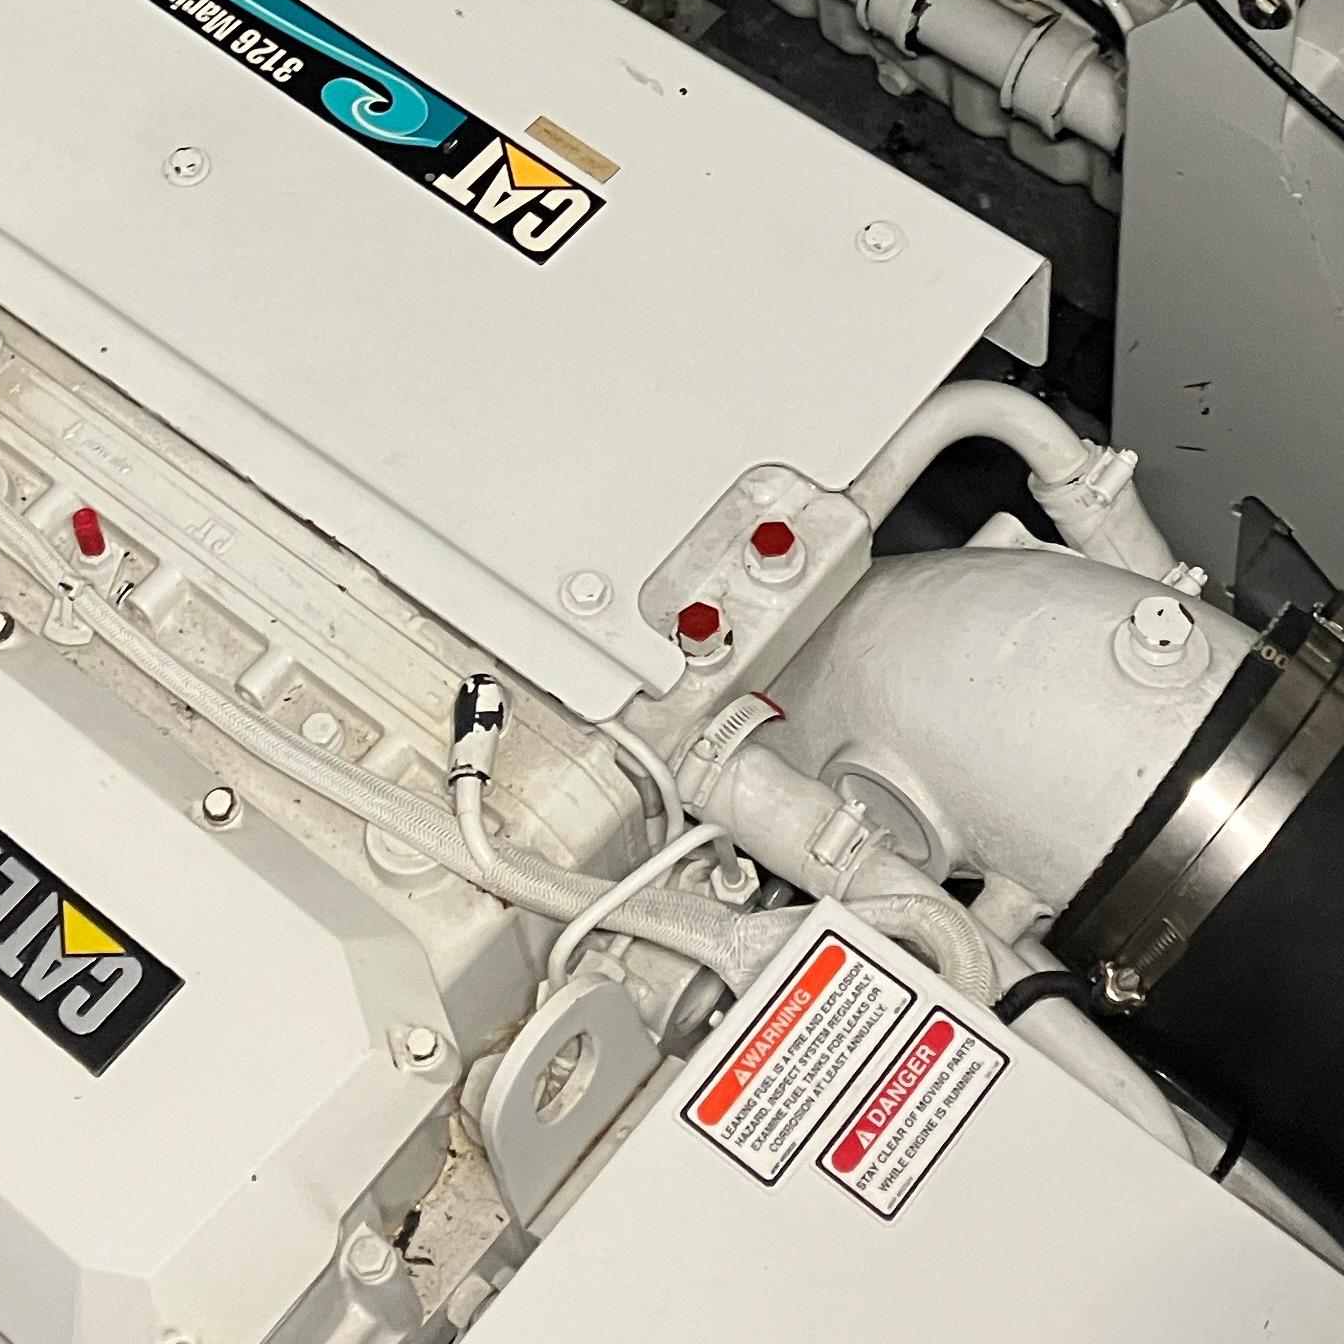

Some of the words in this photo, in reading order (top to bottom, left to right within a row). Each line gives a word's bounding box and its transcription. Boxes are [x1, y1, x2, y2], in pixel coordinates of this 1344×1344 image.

[230, 29, 304, 82] 3126
[432, 136, 591, 252] CAT
[720, 1097, 758, 1141] LEAKING
[753, 1072, 777, 1099] FUEL
[772, 1062, 785, 1075] IS
[780, 1053, 791, 1065] A
[786, 1032, 808, 1056] FIRE
[803, 1011, 825, 1035] AND
[819, 960, 864, 1014] EXPLOSION
[739, 986, 813, 1072] WARNING
[750, 1107, 787, 1152] EXAMINE
[782, 1082, 806, 1110] FUEL
[802, 1051, 830, 1084] TANKS
[825, 1031, 846, 1054] FOR
[841, 1001, 870, 1033] LEAKS
[865, 985, 881, 1003] OR
[766, 1064, 802, 1106] INSPECT
[797, 1026, 831, 1067] SYSTEM
[768, 1095, 816, 1154] CORROSION
[810, 1080, 827, 1098] AT
[821, 1051, 850, 1084] LEAST
[855, 1161, 881, 1191] STAY
[875, 1126, 908, 1164] CLEAR
[902, 1110, 920, 1129] OF
[914, 1069, 951, 1113] MOVING
[946, 1036, 976, 1072] PARTS
[866, 1042, 937, 1128] DANGER
[878, 1157, 909, 1193] WHILE
[903, 1117, 938, 1159] ENGINE
[933, 1106, 947, 1120] IS
